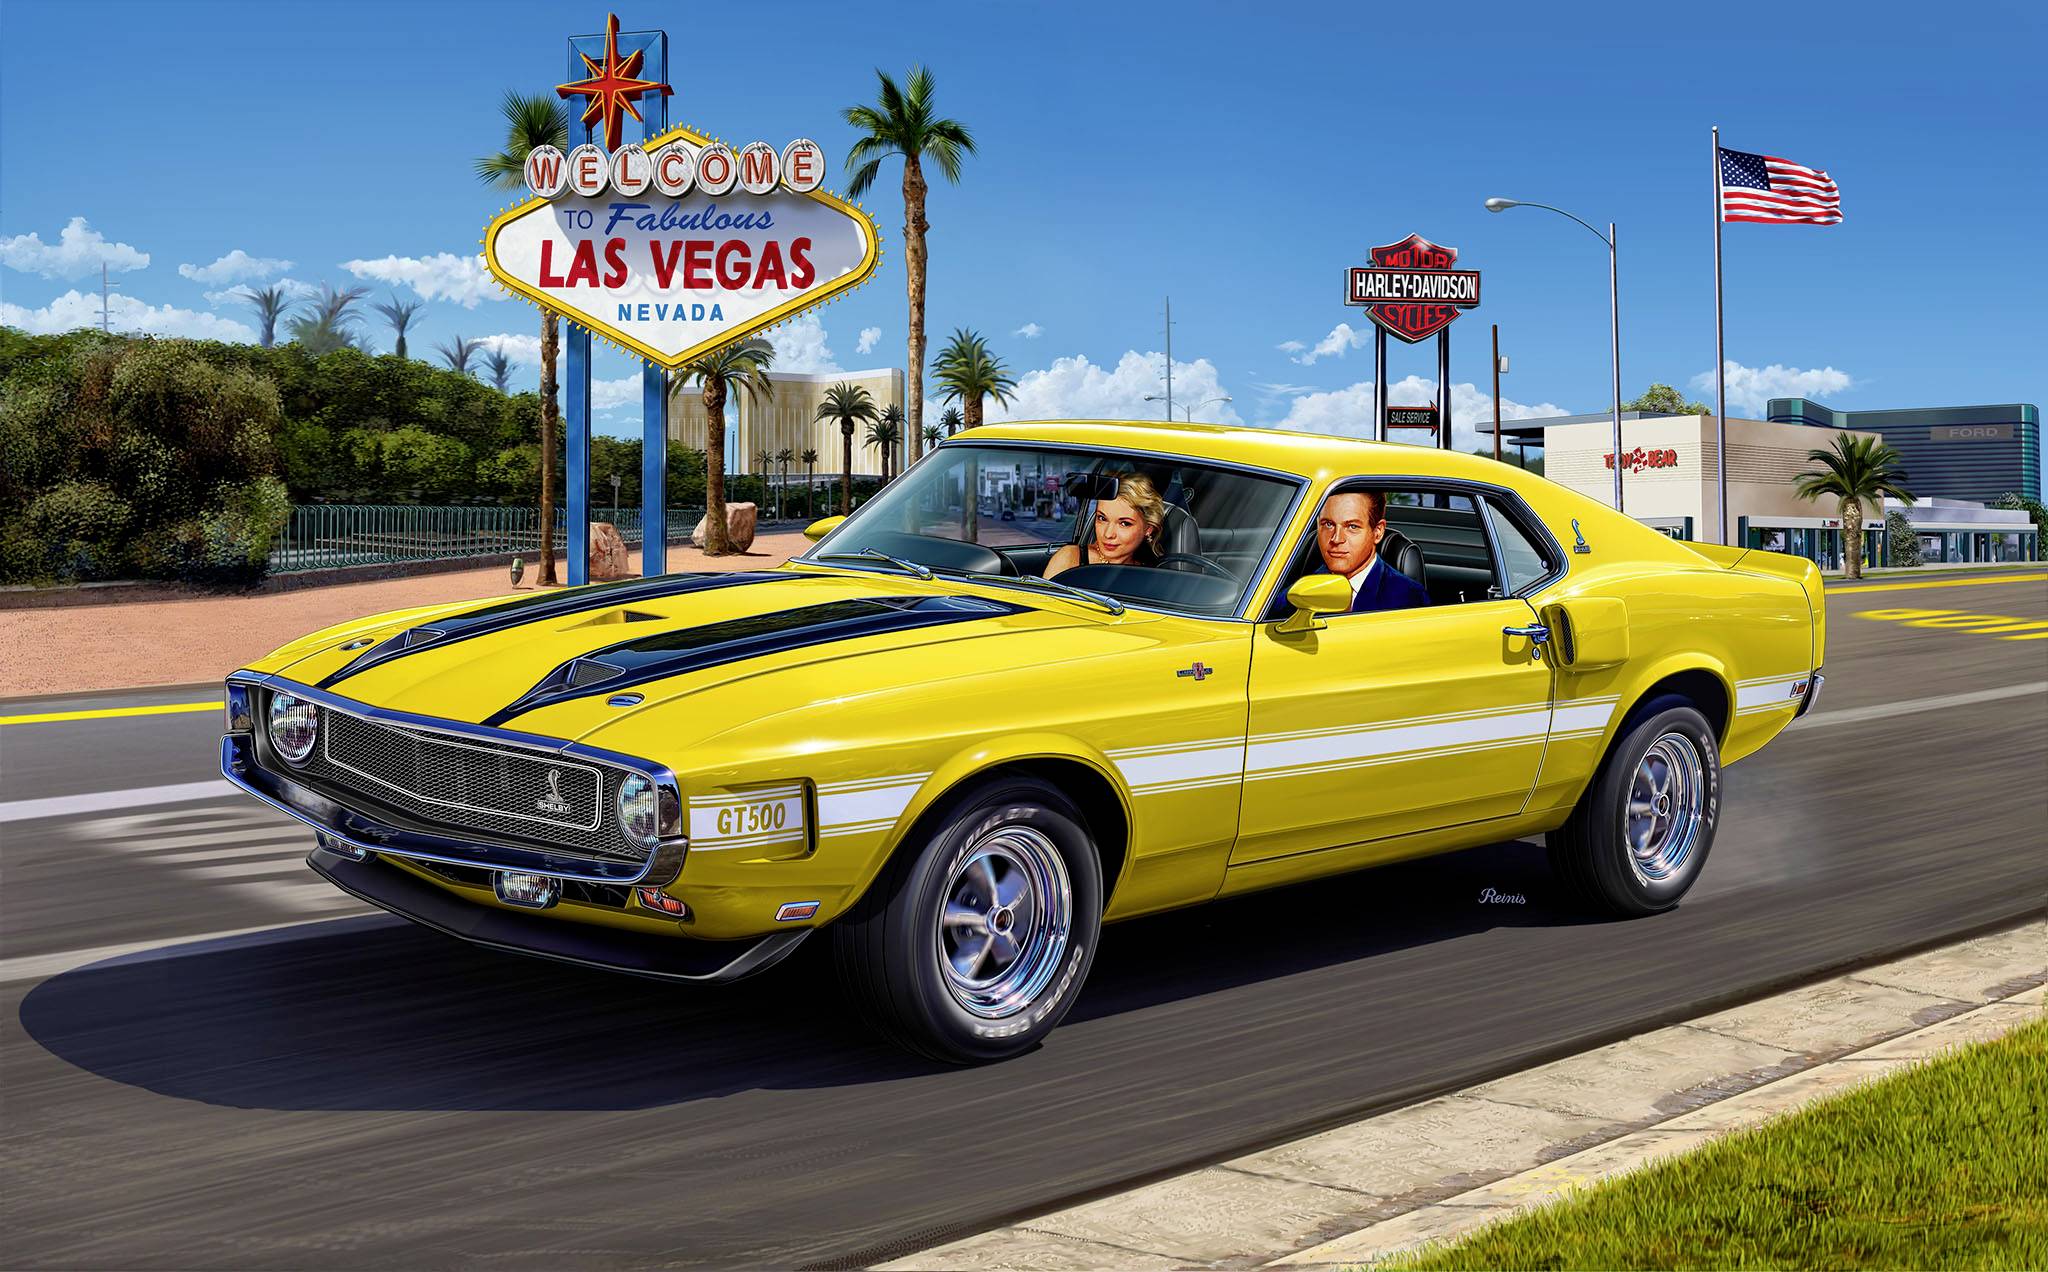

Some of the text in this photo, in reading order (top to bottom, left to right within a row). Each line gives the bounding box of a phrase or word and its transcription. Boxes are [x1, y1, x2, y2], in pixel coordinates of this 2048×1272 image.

[531, 150, 815, 190] WELCOME
[564, 200, 775, 236] TO Fabulous
[538, 237, 816, 290] LAS VEGAS
[1385, 244, 1449, 269] MOTOR
[1355, 272, 1477, 299] HARLEY-DAVIDSON
[617, 302, 724, 322] NEVADA
[1383, 304, 1449, 332] CYCLES
[1391, 411, 1430, 424] SALE SERVICE
[1950, 426, 1998, 439] FORD
[1647, 448, 1679, 468] BEAR
[538, 800, 570, 812] SHELBY
[717, 801, 786, 835] GT500
